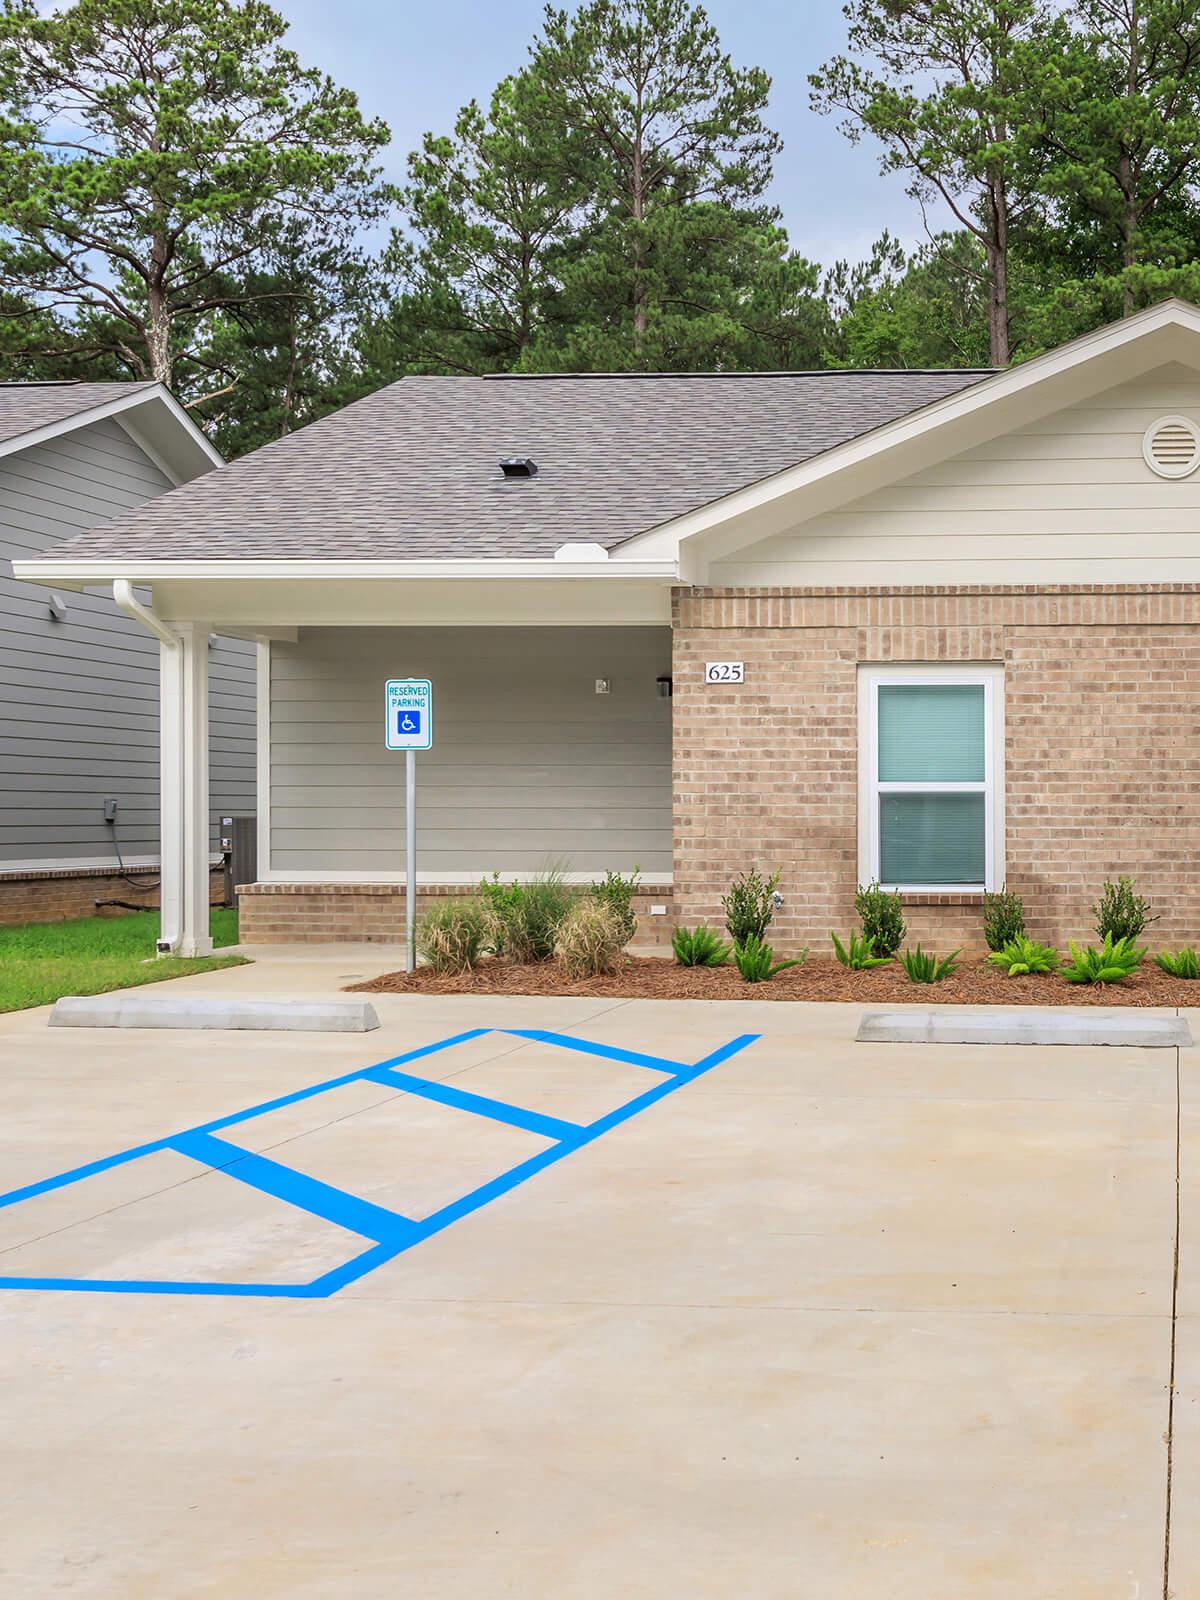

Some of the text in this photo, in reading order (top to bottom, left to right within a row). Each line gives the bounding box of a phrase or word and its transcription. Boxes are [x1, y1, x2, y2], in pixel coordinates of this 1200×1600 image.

[709, 665, 741, 681] 625
[389, 687, 428, 696] RESERVED
[392, 698, 425, 708] PARKING
